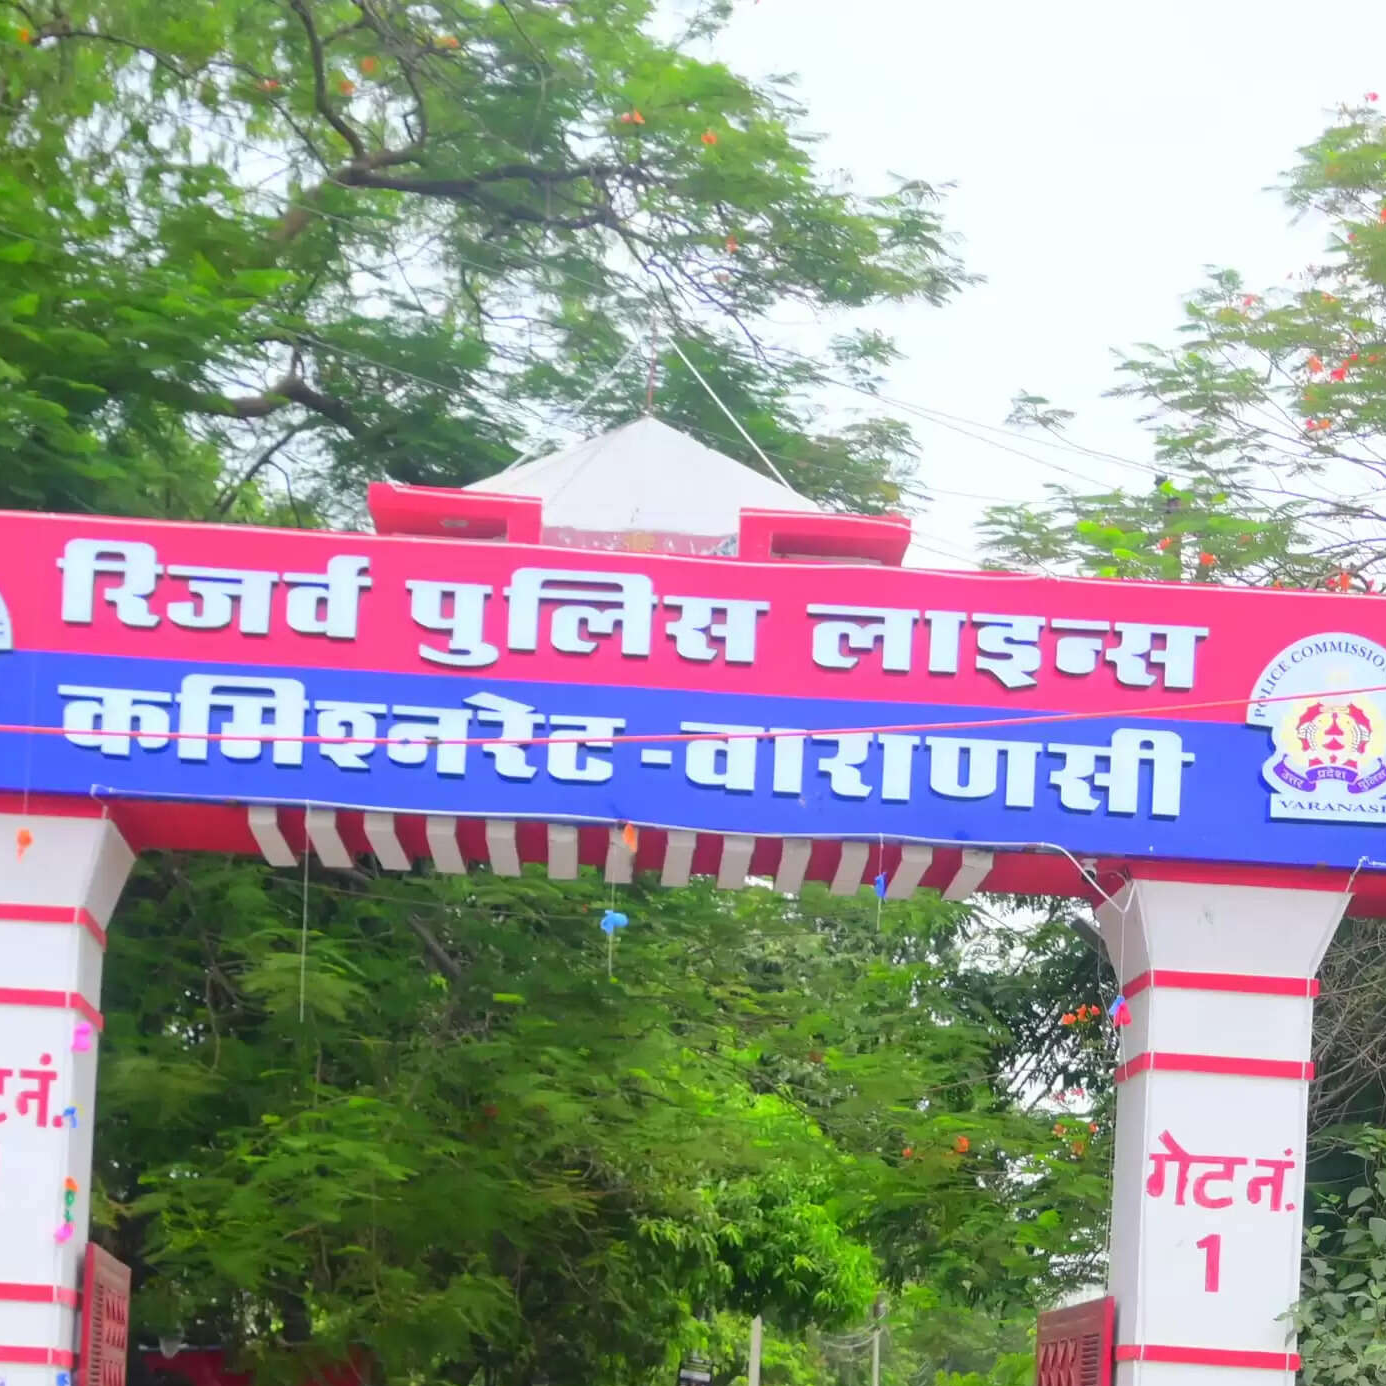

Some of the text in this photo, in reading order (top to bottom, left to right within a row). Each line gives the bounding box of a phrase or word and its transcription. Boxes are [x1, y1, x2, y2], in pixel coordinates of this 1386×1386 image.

[56, 538, 1209, 689] रिजर्व पुलिस लाइन्स
[57, 673, 627, 784] कमिश्नरेट
[1254, 661, 1292, 719] POLICE
[1196, 1233, 1221, 1292] 1
